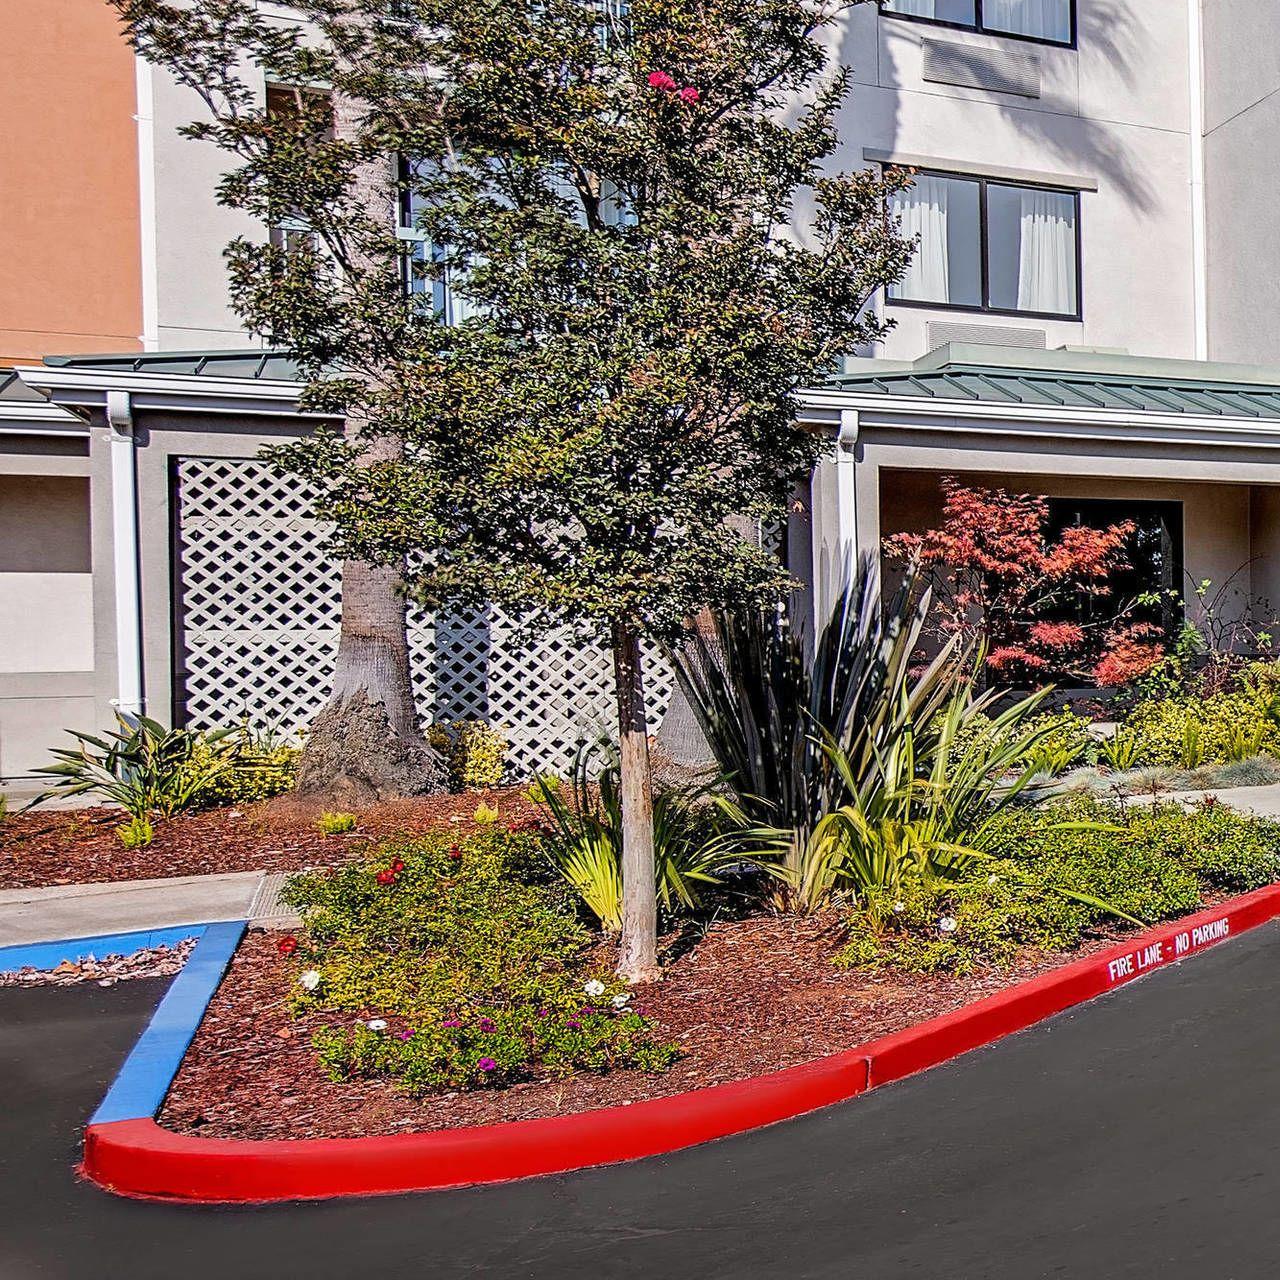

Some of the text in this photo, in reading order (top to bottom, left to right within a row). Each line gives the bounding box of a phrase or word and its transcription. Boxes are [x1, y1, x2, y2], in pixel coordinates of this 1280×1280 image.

[1108, 954, 1135, 981] FIRE
[1137, 942, 1163, 968] LANE
[1175, 932, 1190, 954] NO
[1192, 917, 1229, 947] PARKING
